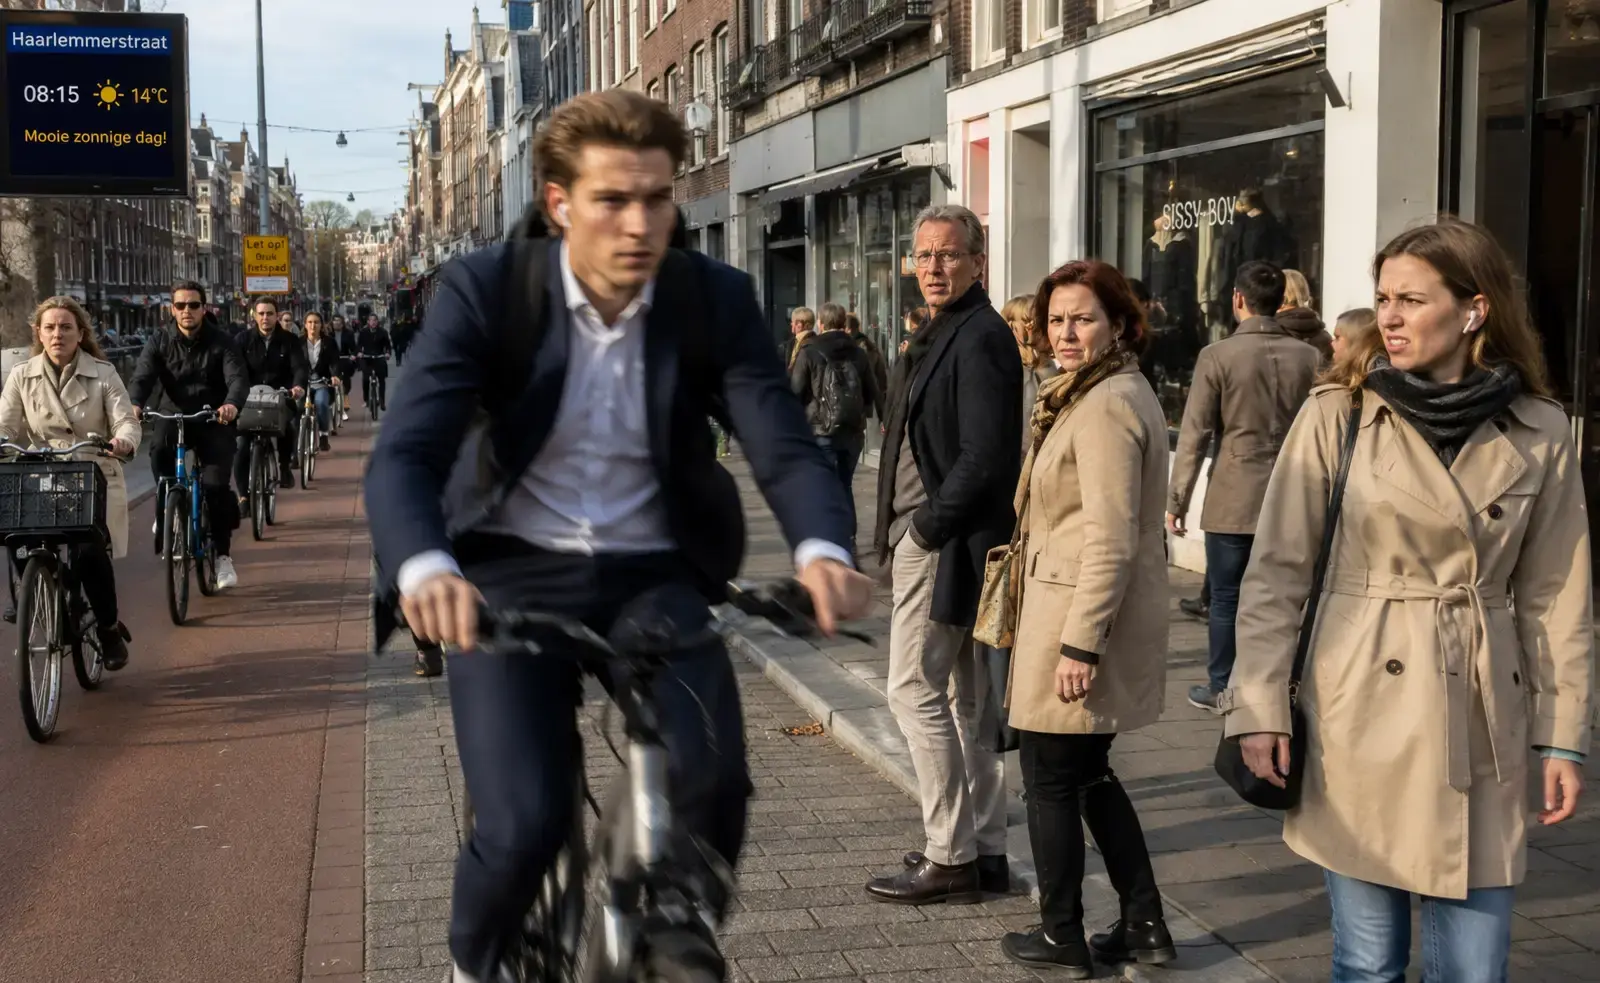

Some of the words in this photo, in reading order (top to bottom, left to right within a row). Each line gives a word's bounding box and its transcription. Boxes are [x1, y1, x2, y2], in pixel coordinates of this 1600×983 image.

[12, 31, 168, 50] Haarlemmerstraat
[23, 85, 80, 104] 08:15
[131, 87, 168, 104] 14°C
[24, 129, 70, 143] Mooie
[73, 130, 132, 147] zonnige
[135, 131, 167, 147] dag!
[1162, 196, 1236, 230] SISSY-BOY
[246, 240, 264, 248] Let
